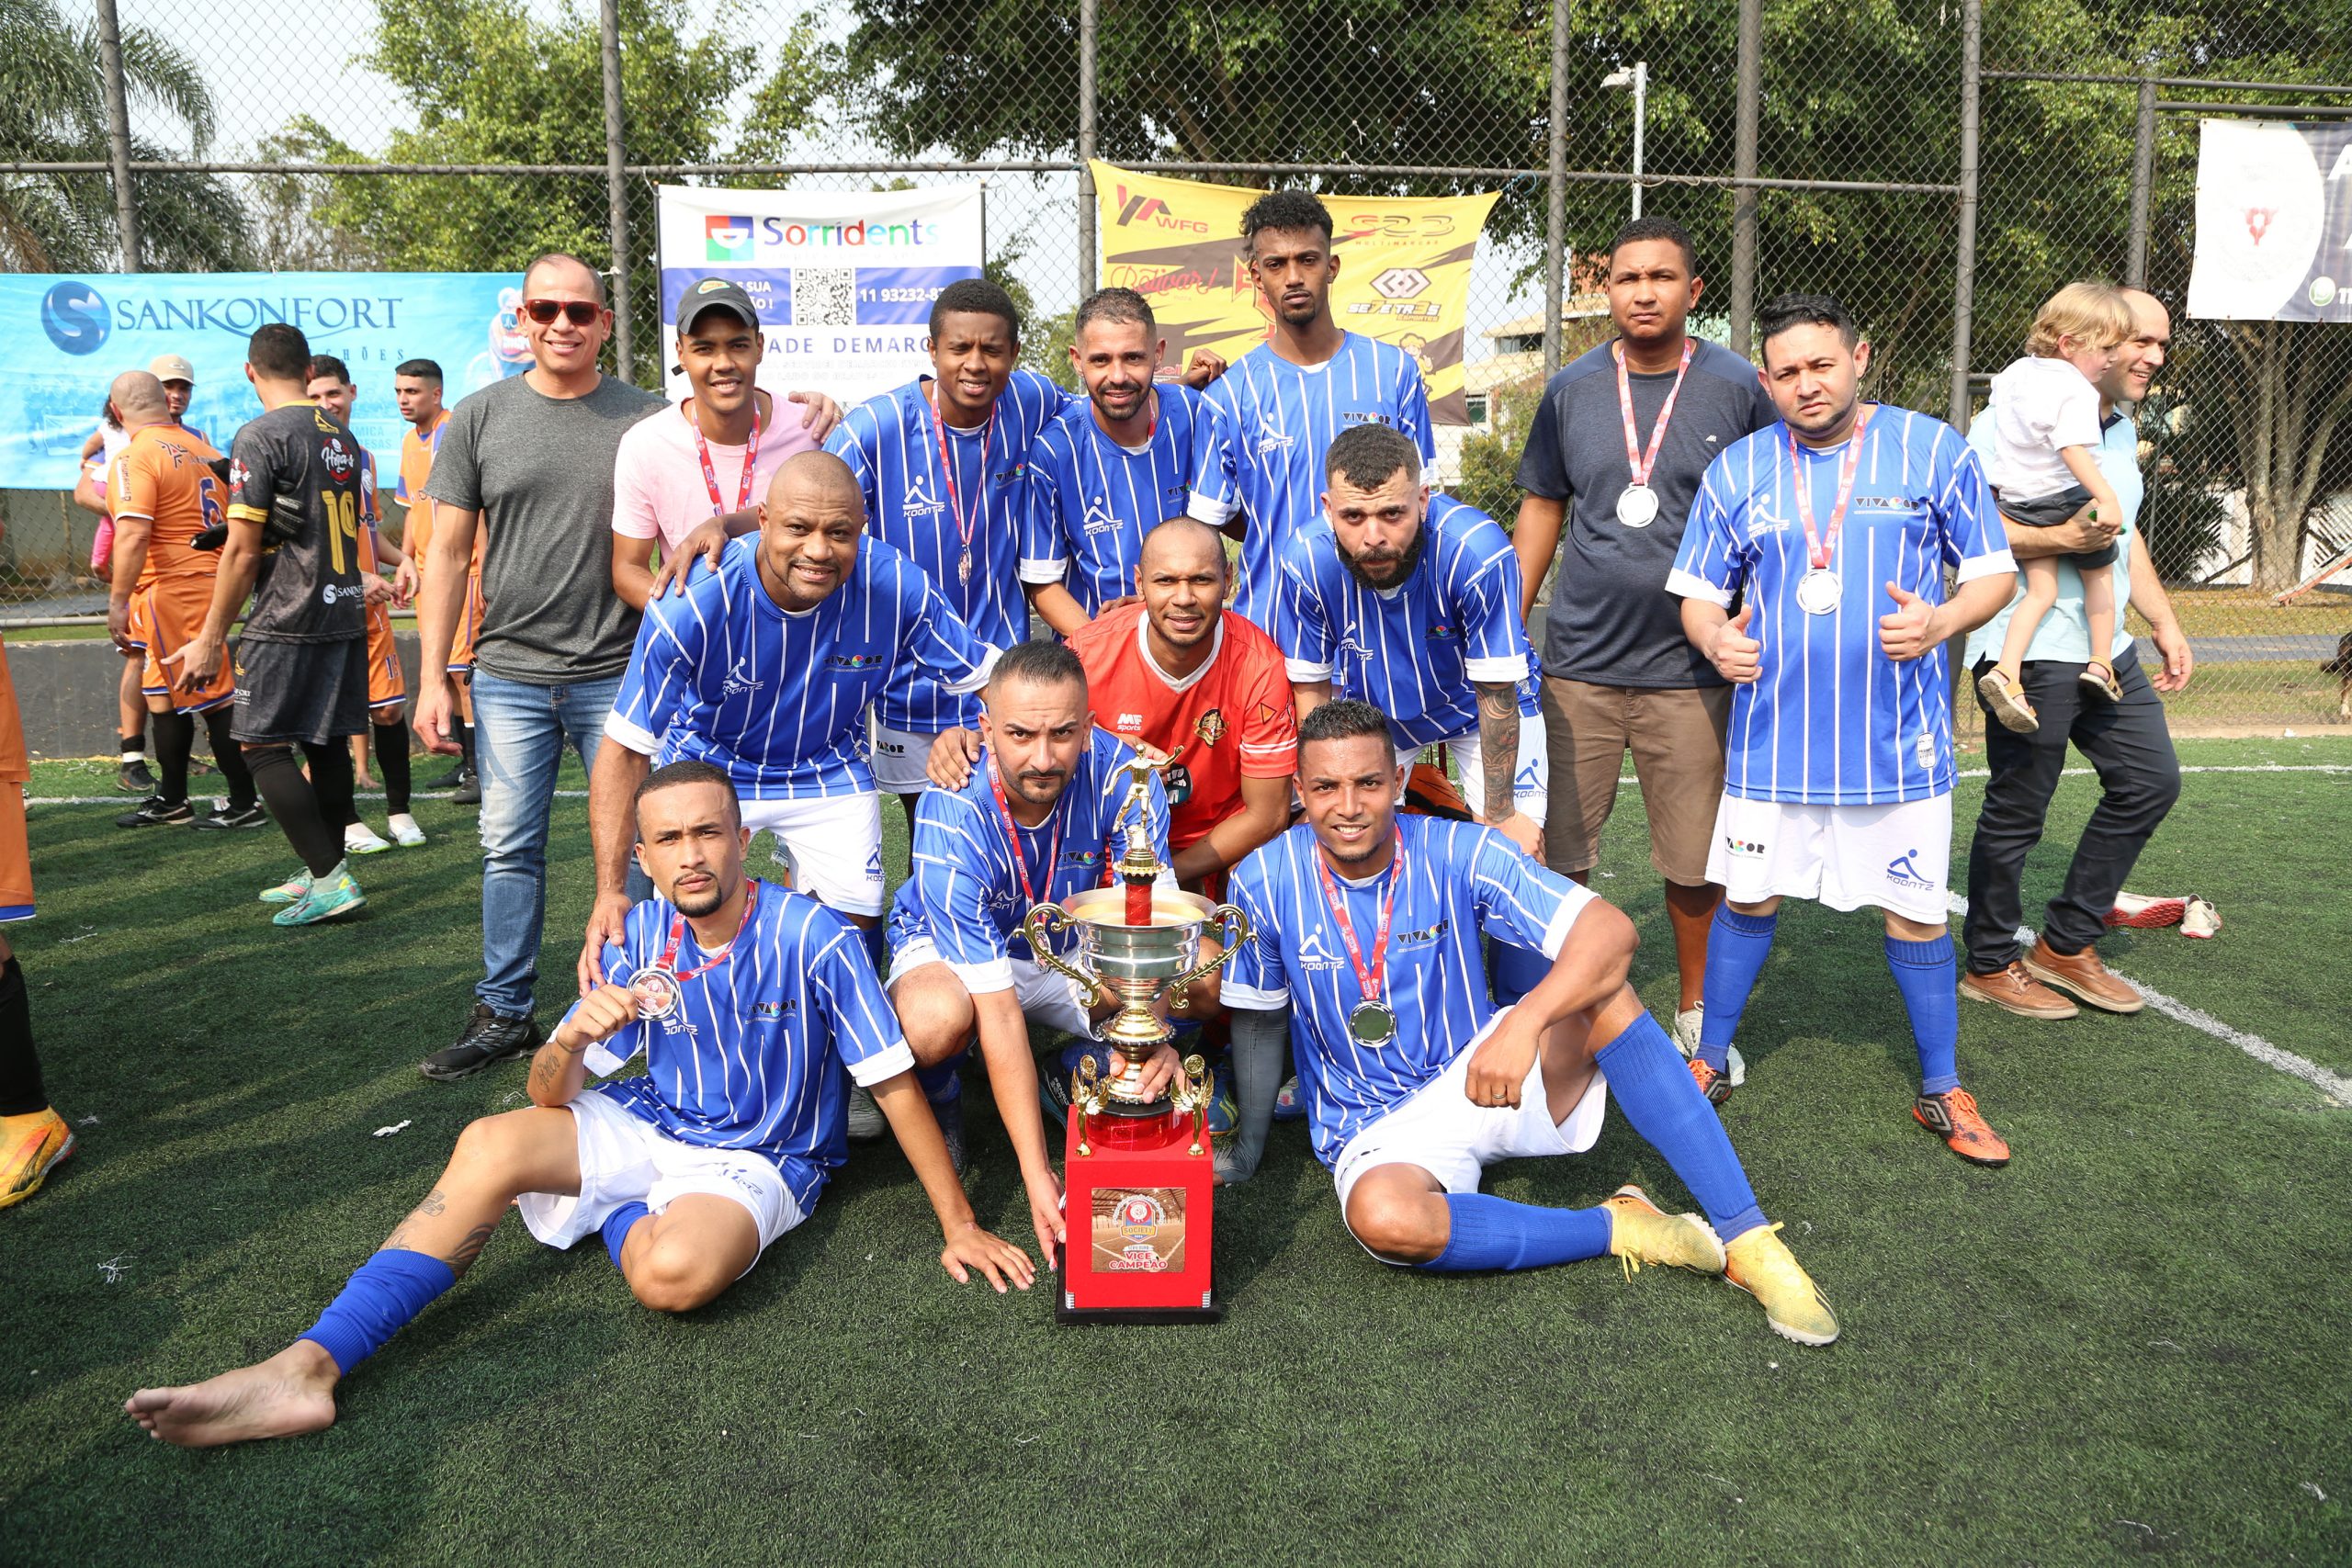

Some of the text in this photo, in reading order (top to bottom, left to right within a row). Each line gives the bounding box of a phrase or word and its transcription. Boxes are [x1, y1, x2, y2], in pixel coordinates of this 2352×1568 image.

[763, 217, 939, 246] Sorridents
[1156, 216, 1208, 233] WFG
[747, 281, 772, 292] SUA
[860, 288, 876, 302] 11
[118, 298, 402, 333] SANKONFORT
[1343, 412, 1391, 424] VIVACOR
[1258, 438, 1294, 455] KOONTZ
[199, 477, 224, 528] 6
[903, 504, 944, 517] KOONTZ
[1085, 522, 1123, 536] KOONTZ
[1886, 874, 1934, 891] KOONTZ
[1301, 961, 1344, 971] KOONTZ
[1110, 1260, 1167, 1269] CAMPEÃO
